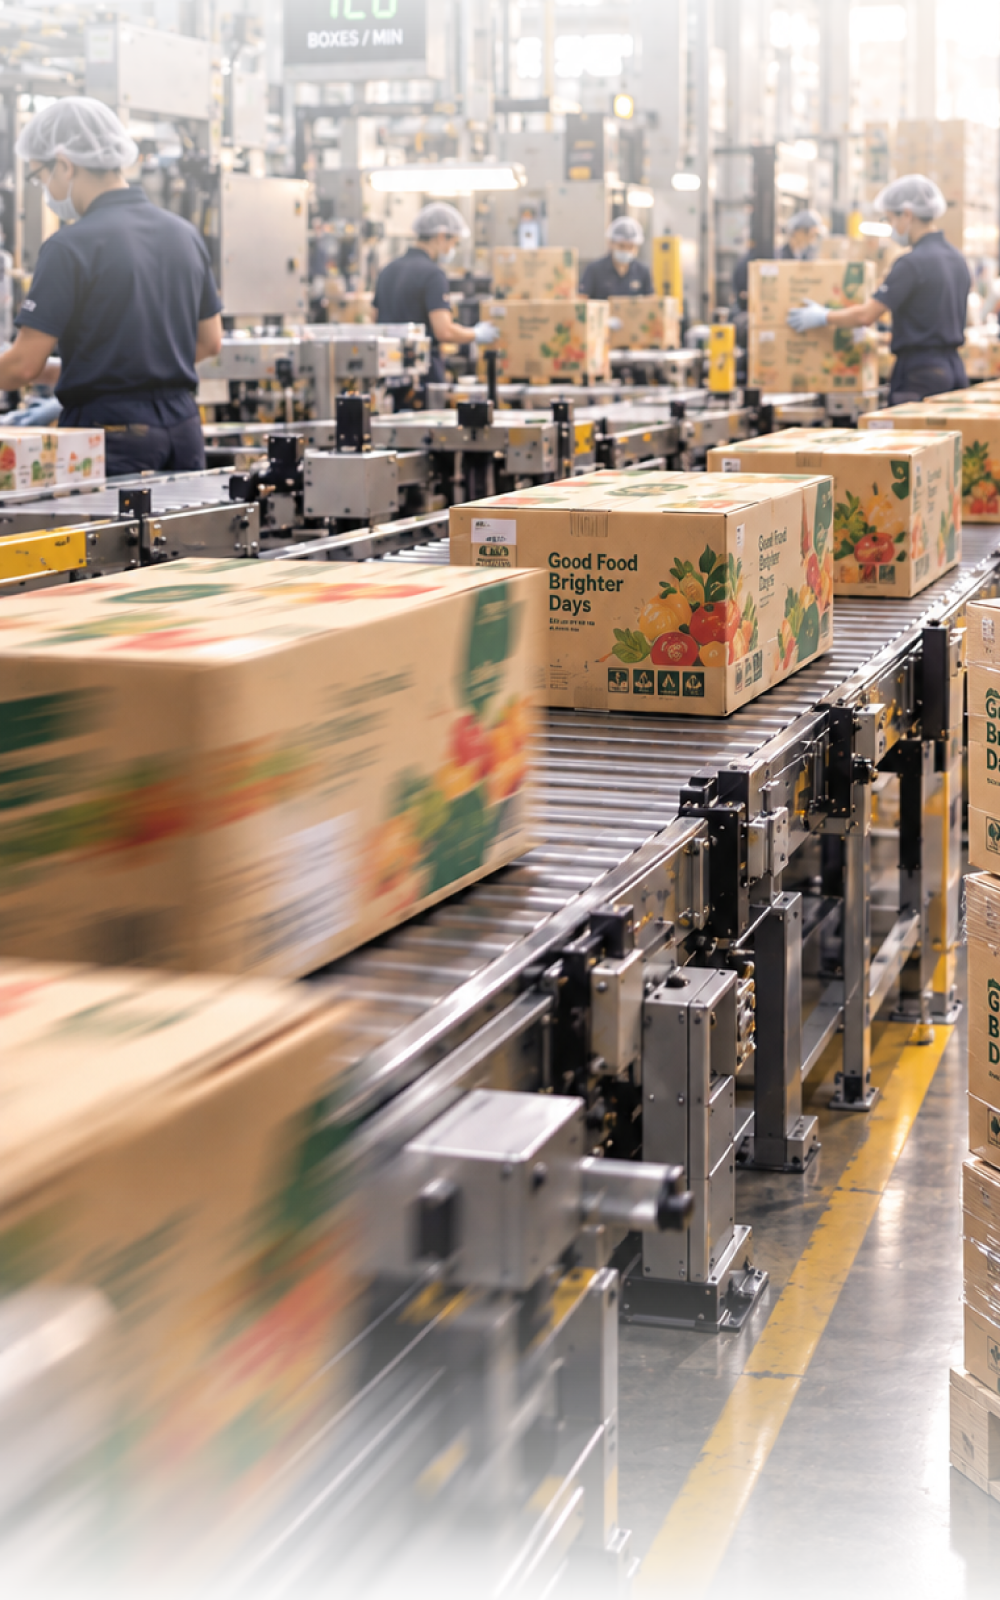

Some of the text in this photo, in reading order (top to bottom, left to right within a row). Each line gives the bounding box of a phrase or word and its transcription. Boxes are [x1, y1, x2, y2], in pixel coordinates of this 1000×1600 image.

[307, 28, 403, 49] BOXES / MIN
[548, 551, 638, 571] Good Food
[549, 571, 624, 596] Brighter
[549, 594, 592, 617] Days
